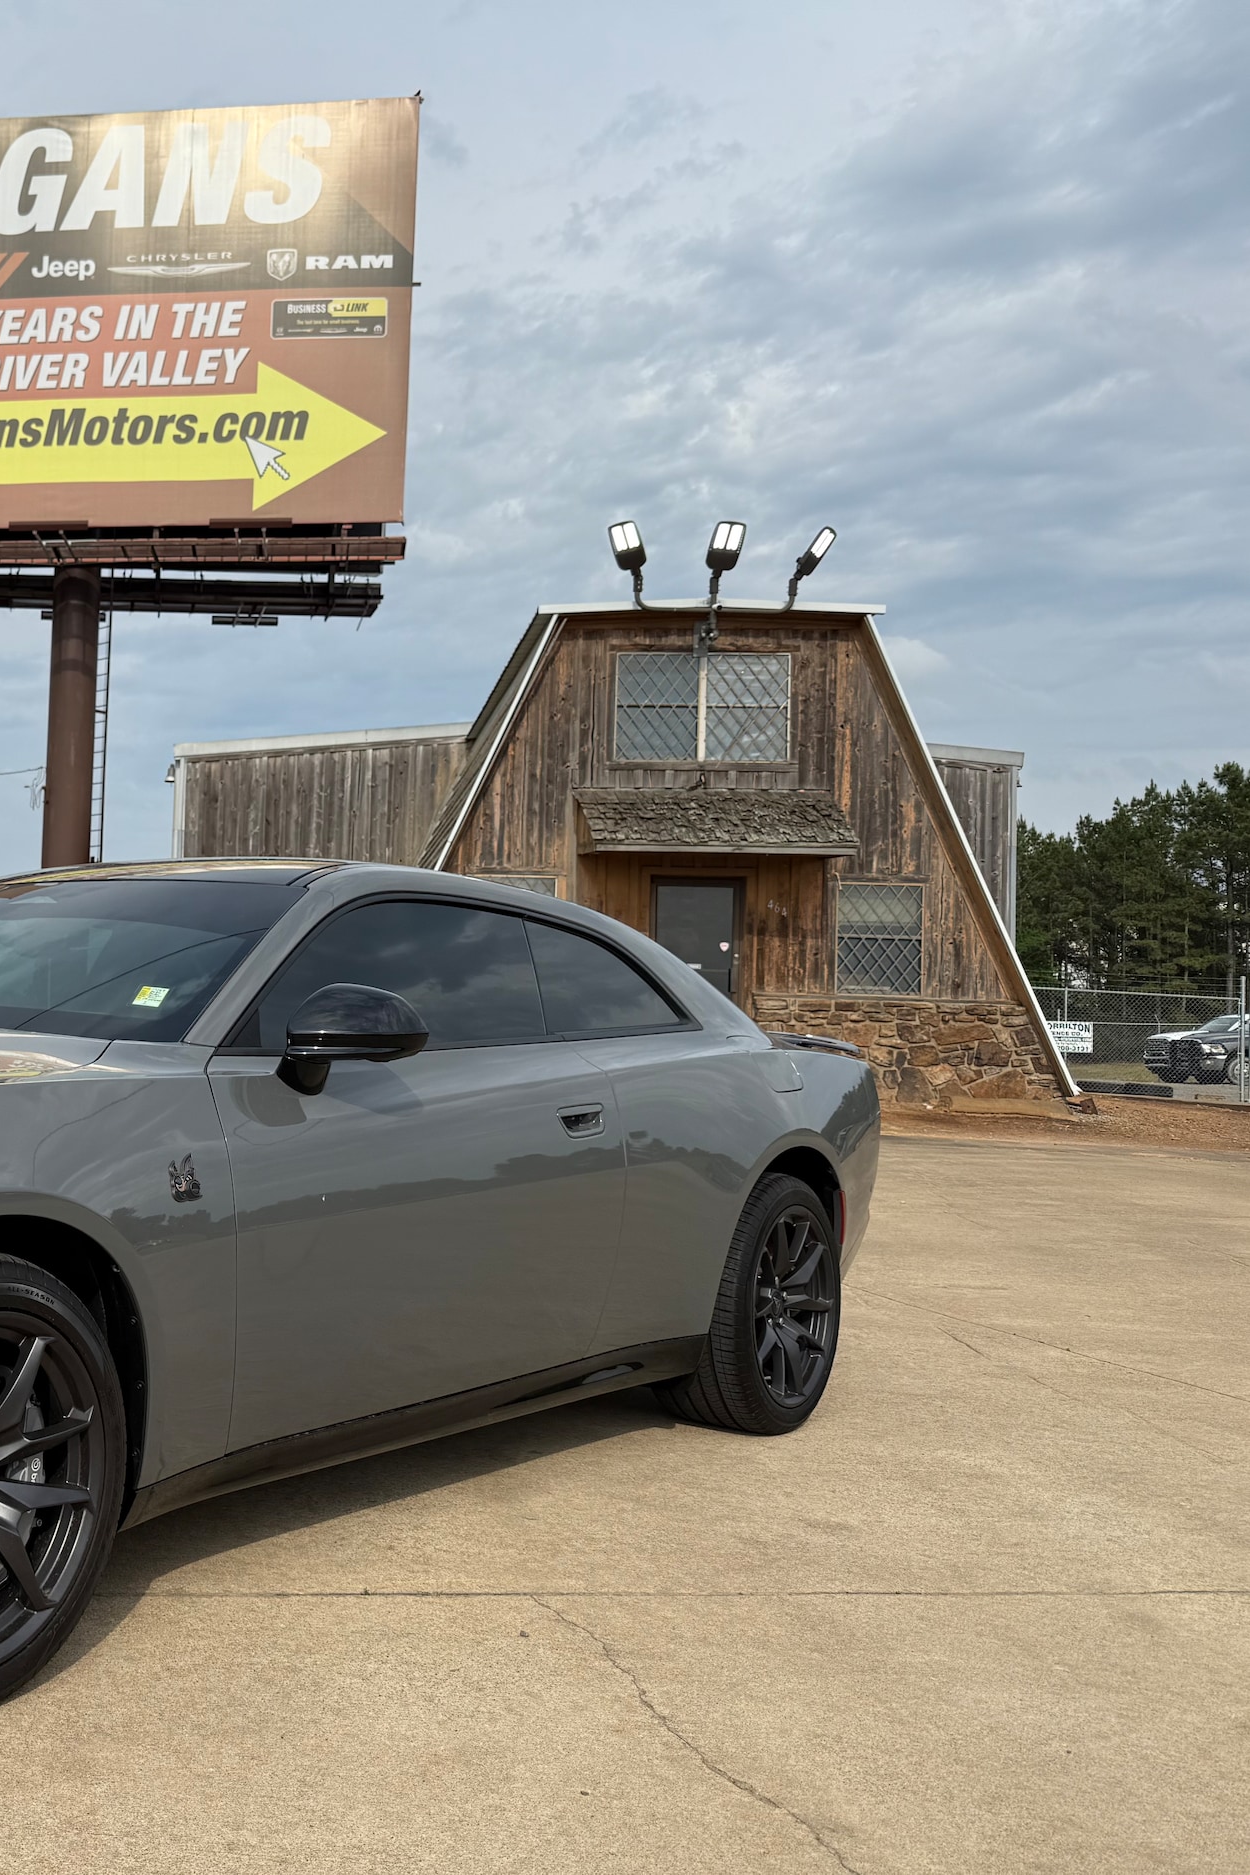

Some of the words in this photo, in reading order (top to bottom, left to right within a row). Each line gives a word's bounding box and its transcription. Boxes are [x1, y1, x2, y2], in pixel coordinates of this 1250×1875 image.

[126, 251, 233, 263] CHRYSLER
[305, 254, 394, 271] RAM
[31, 255, 96, 281] Jeep
[345, 302, 369, 313] LINK
[113, 303, 160, 341] IN
[171, 301, 248, 339] THE
[102, 347, 251, 389] VALLEY
[7, 1286, 55, 1305] ALL-SEASON
